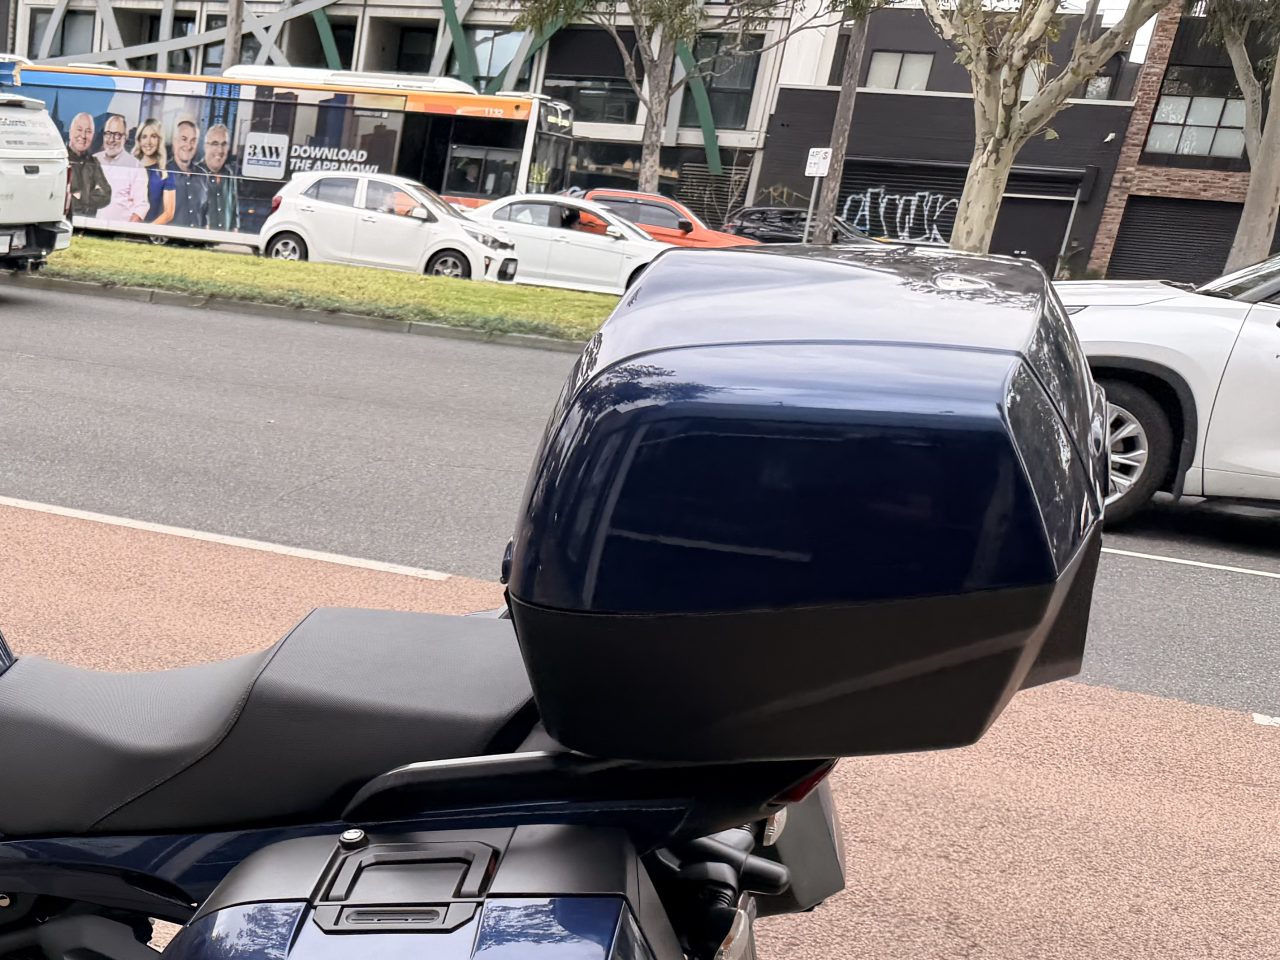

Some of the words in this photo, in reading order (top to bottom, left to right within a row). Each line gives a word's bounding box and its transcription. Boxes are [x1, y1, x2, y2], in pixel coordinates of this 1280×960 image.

[248, 144, 281, 159] 3AW
[290, 145, 368, 162] DOWNLOAD
[289, 159, 312, 171] THE
[313, 161, 338, 172] APP
